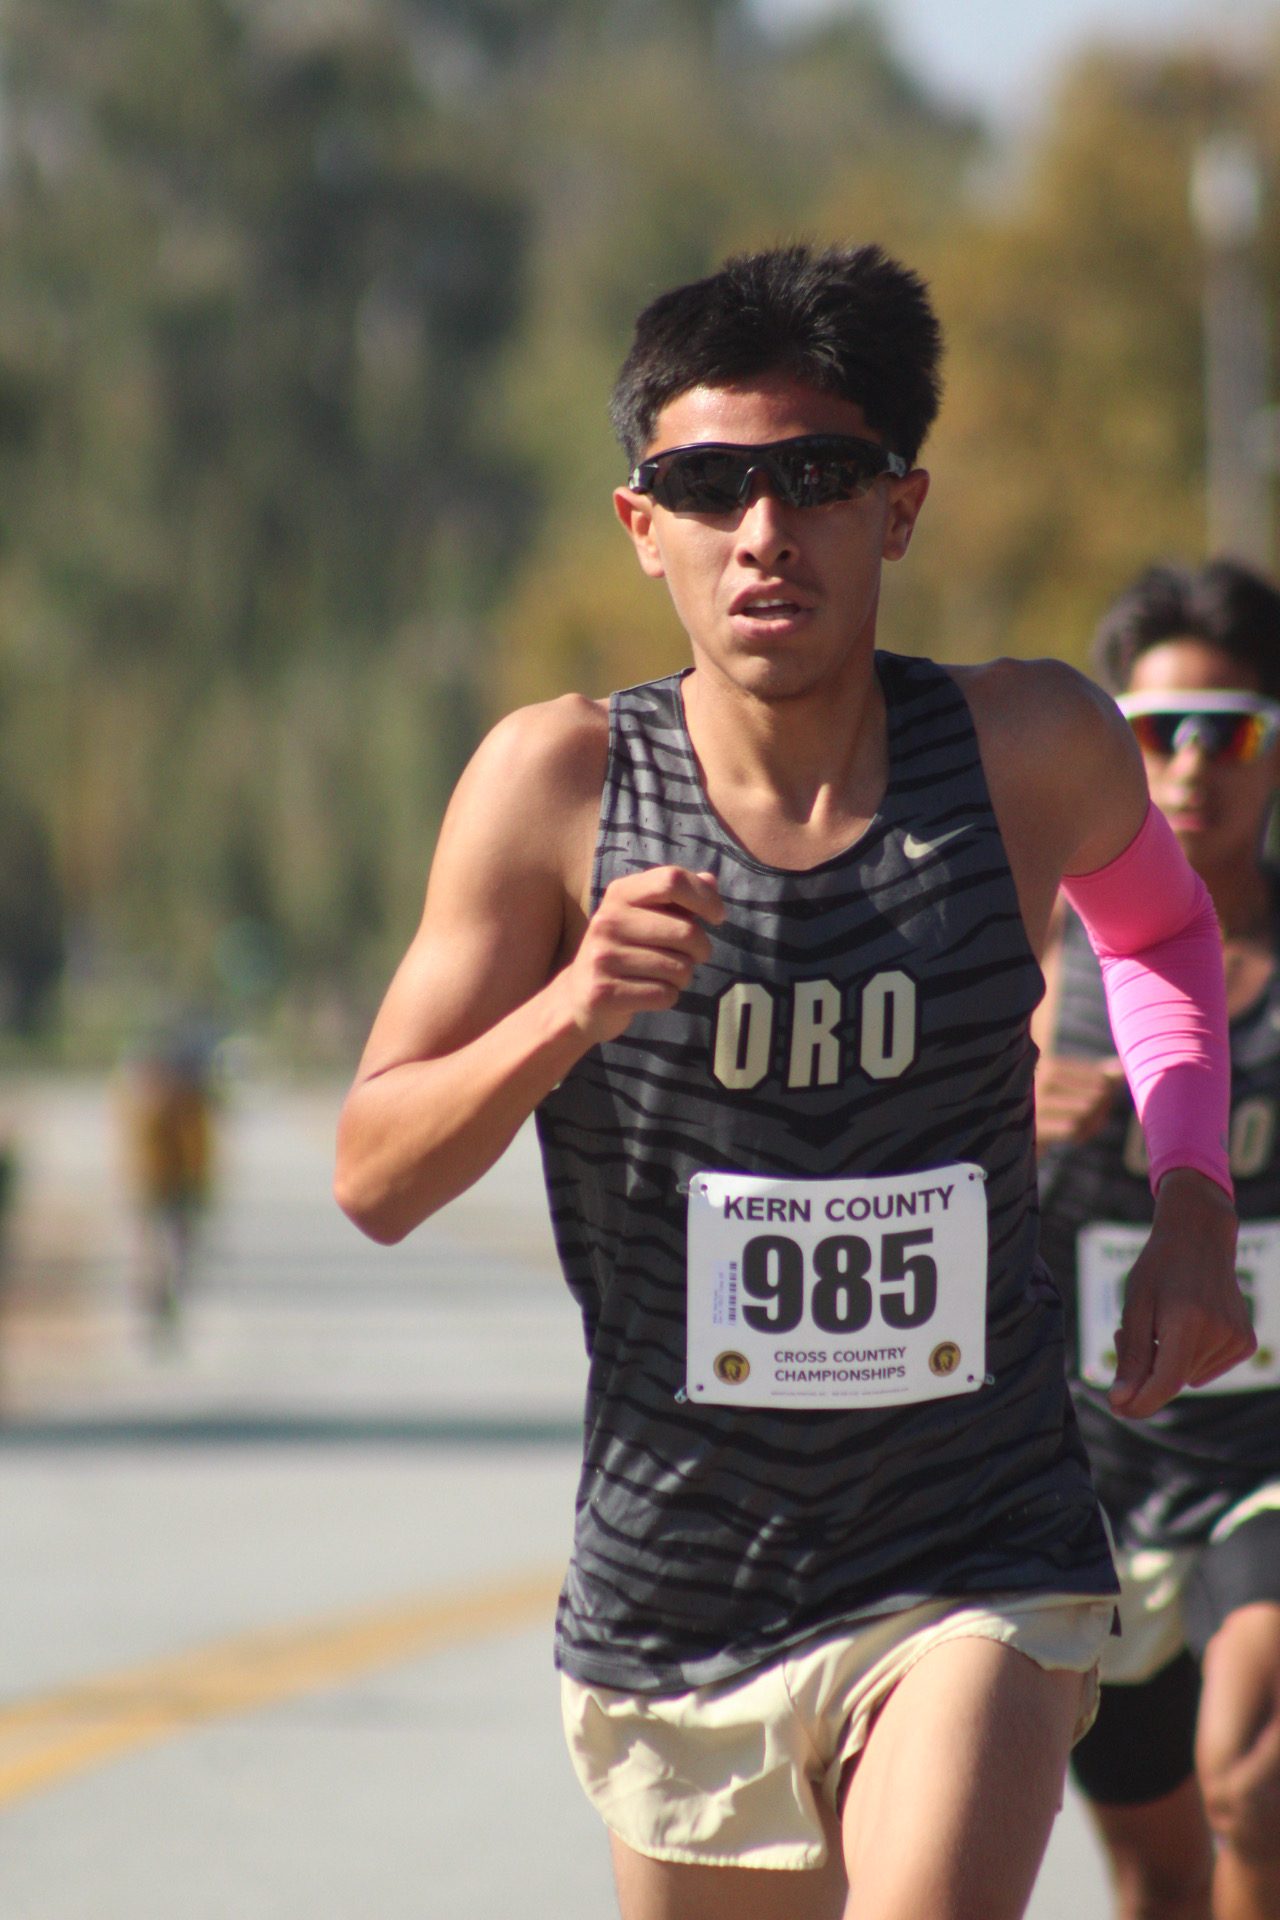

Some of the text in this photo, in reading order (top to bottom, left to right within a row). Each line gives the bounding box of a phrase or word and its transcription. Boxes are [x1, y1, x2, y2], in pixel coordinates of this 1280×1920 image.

[712, 969, 917, 1090] ORO
[723, 1184, 955, 1222] KERN COUNTY
[741, 1227, 938, 1335] 985
[773, 1347, 907, 1363] CROSS COUNTRY
[774, 1365, 907, 1382] CHAMPIONSHIPS
